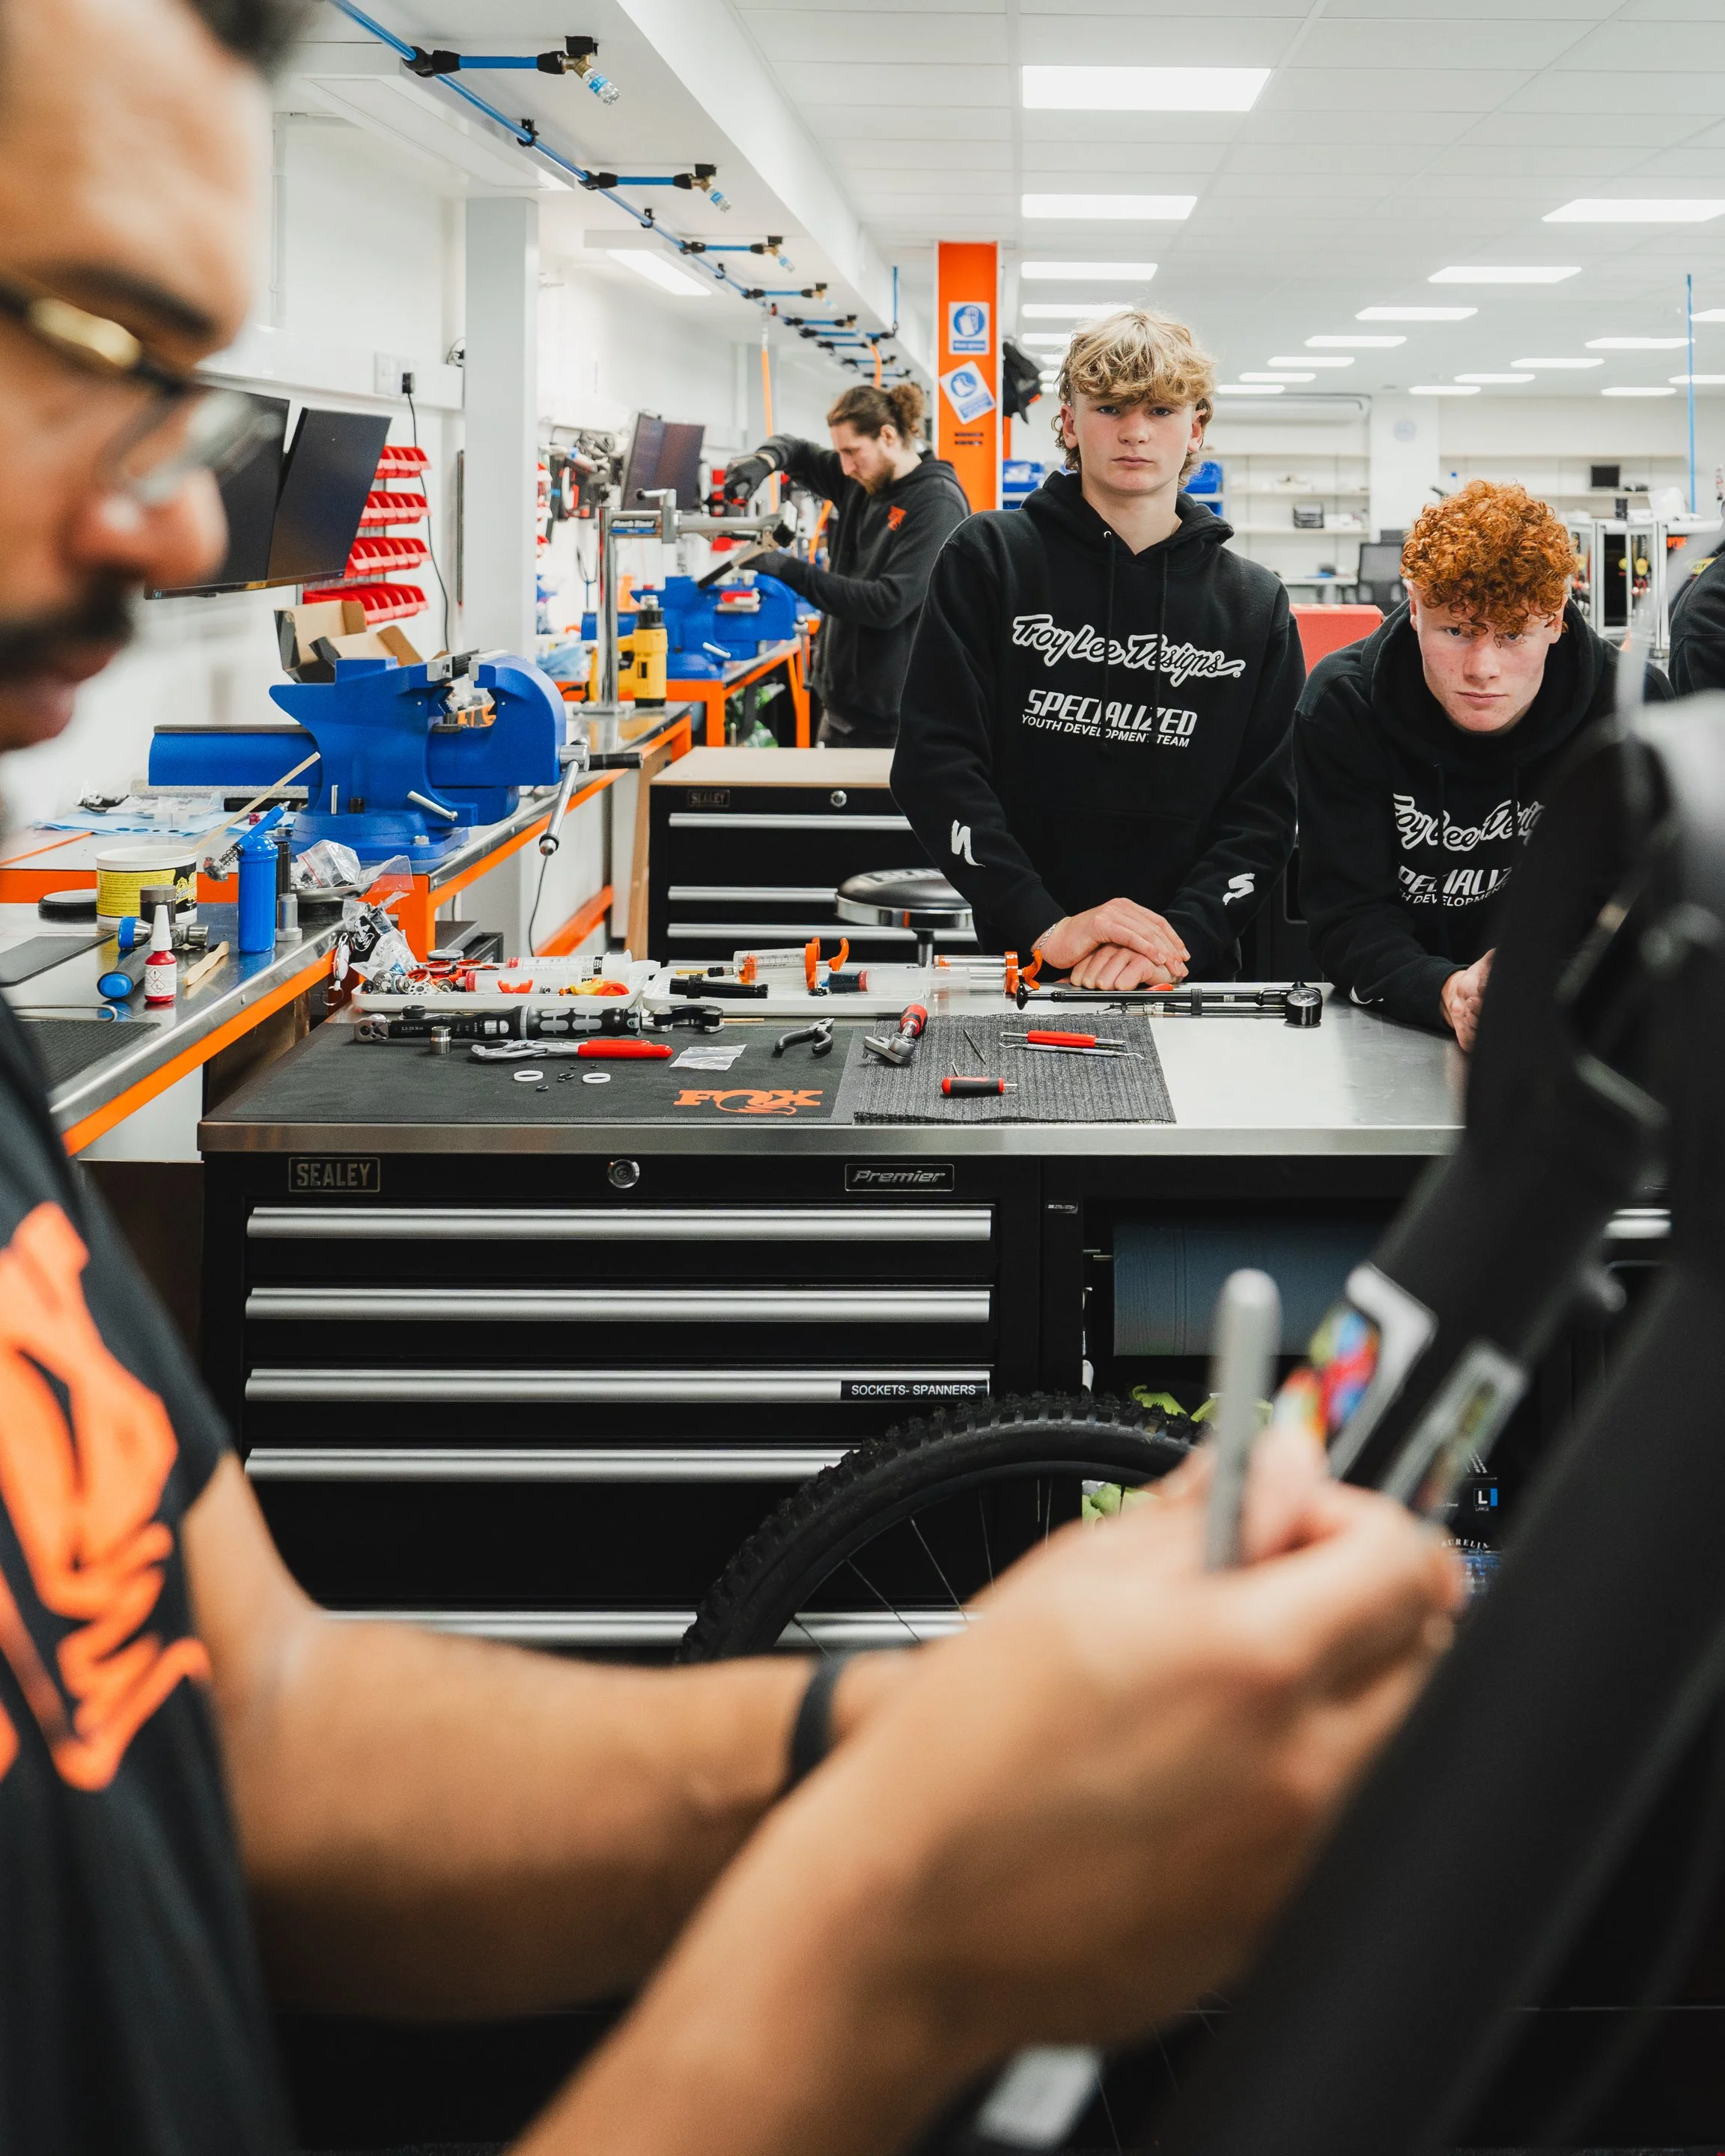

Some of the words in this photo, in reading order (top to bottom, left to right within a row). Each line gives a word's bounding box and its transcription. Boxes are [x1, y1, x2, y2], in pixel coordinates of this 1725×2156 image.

[1024, 689, 1198, 736] SPECIALIZED
[1022, 714, 1062, 731] YOUTH
[1064, 722, 1150, 743] DEVELOPMEN
[1157, 734, 1190, 747] TEAM
[673, 1089, 824, 1115] FOX
[296, 1163, 371, 1187] SEALEY
[852, 1170, 946, 1183] Premier
[851, 1385, 910, 1395] SOCKETS-
[913, 1385, 976, 1395] SPANNERS
[1478, 1490, 1488, 1505] L
